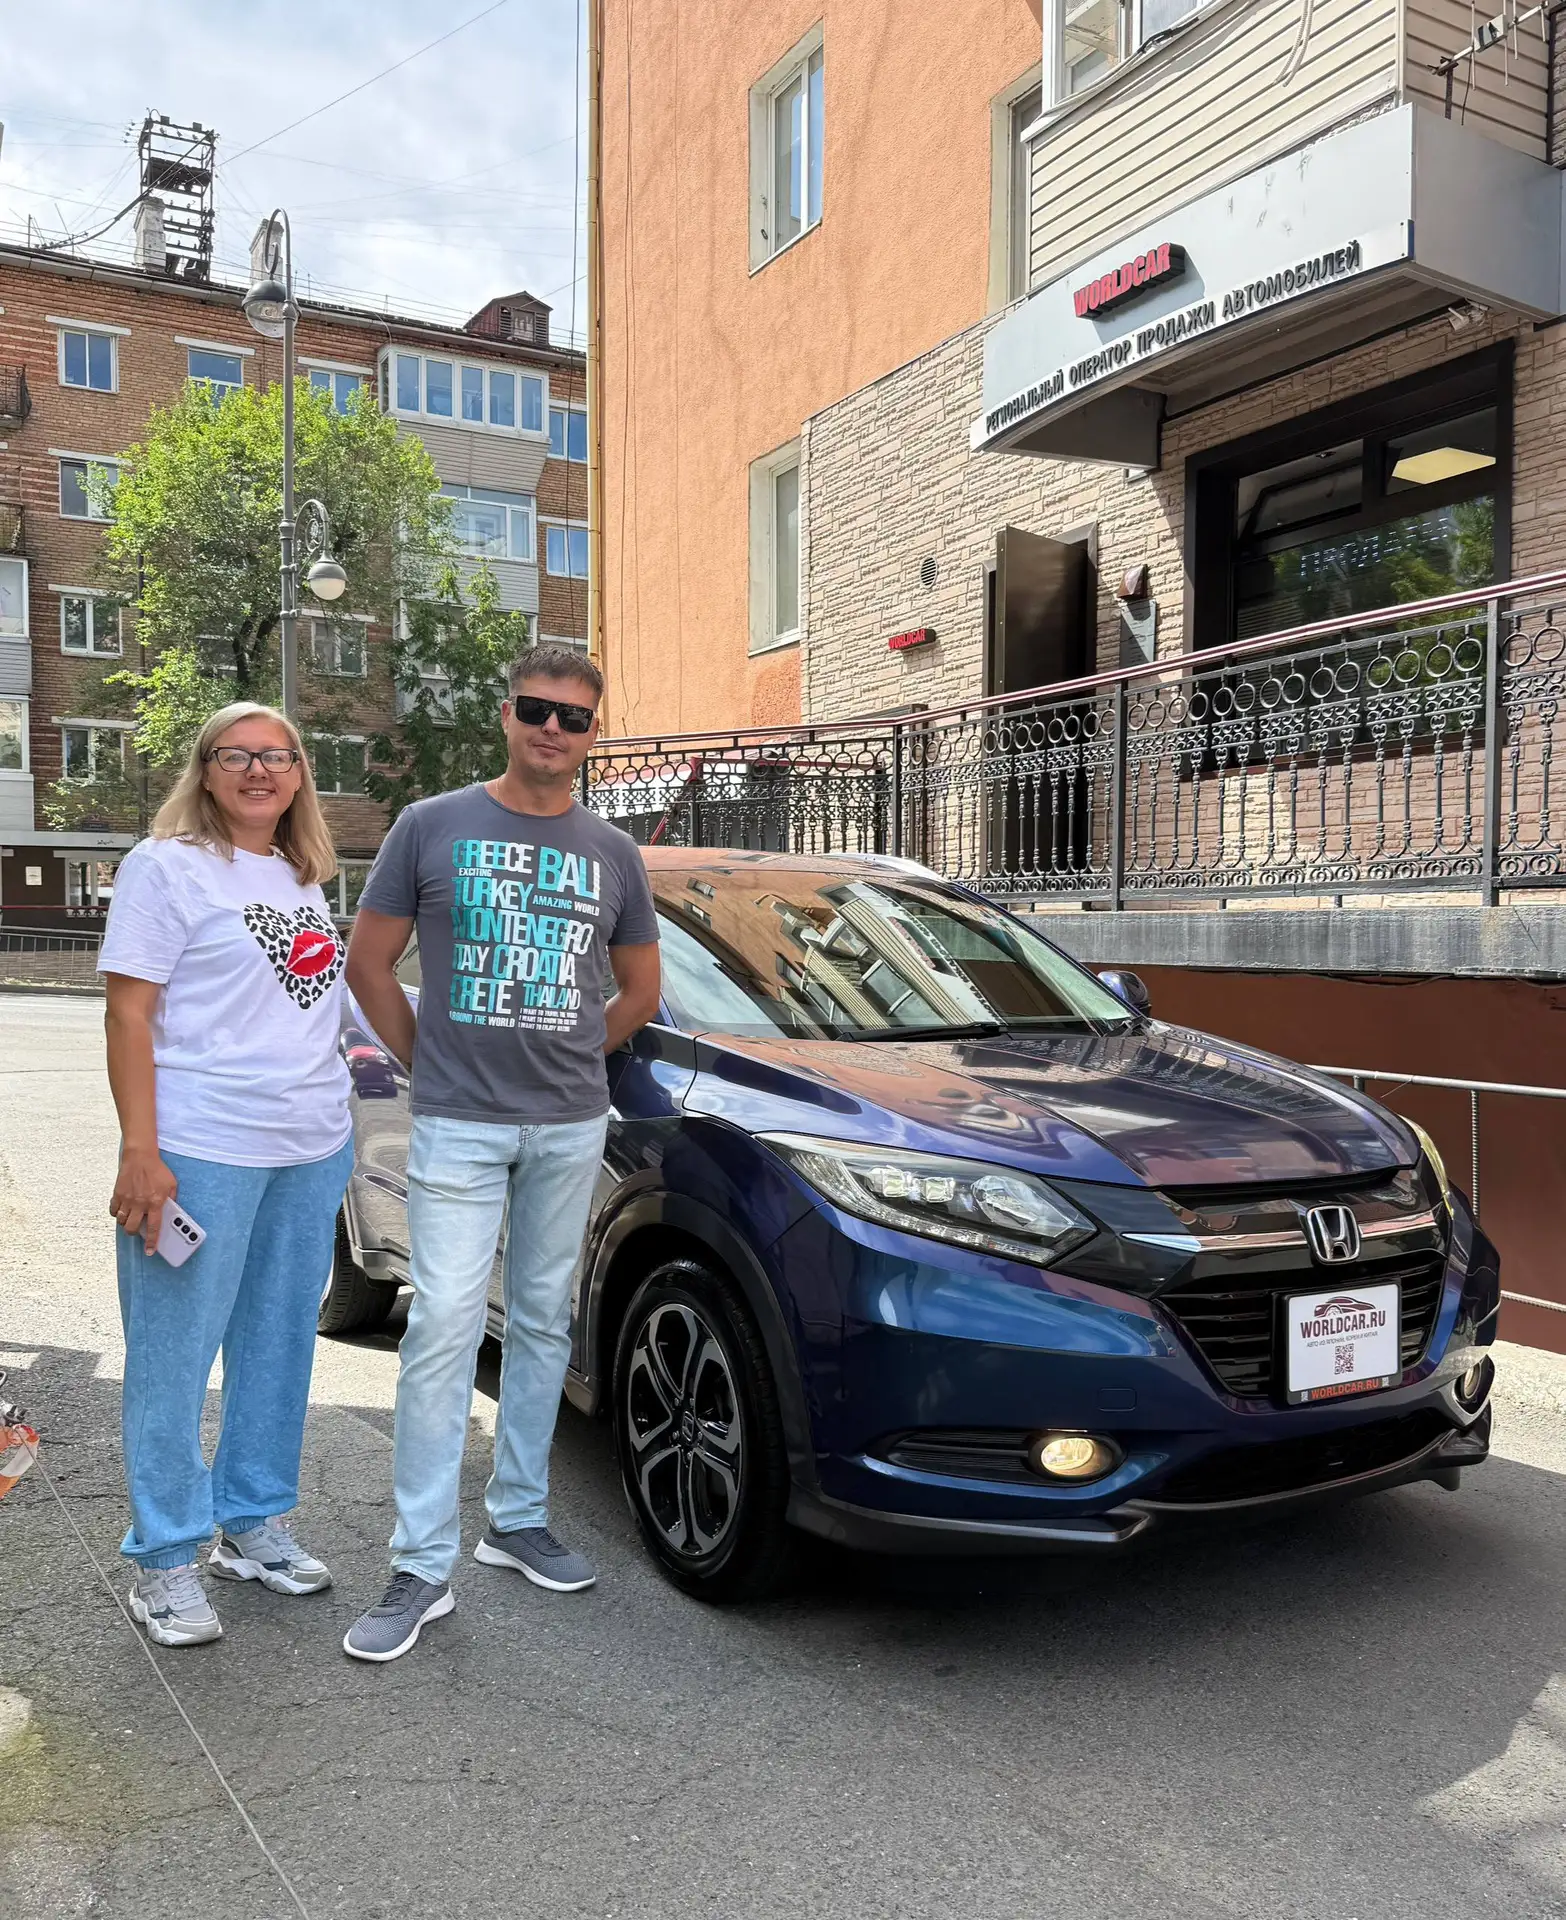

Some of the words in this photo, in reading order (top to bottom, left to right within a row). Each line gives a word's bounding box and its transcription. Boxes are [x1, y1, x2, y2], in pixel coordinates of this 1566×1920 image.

[1074, 242, 1171, 317] WORLDCAR
[986, 368, 1064, 435] РЕГИОНАЛЬНЫЙ
[1069, 340, 1132, 387] ОПЕРАТОР
[1136, 301, 1216, 355] ПРОДАЖИ
[1222, 239, 1362, 318] АВТОМОБИЛЕЙ
[888, 628, 926, 649] WORLDCAR
[452, 839, 534, 874] GREECE
[458, 867, 492, 877] EXCITING
[537, 846, 600, 901] BALI
[451, 876, 534, 912] TURKEY
[532, 895, 572, 910] AMAZING
[574, 900, 600, 917] WORLD
[450, 906, 594, 955] MONTENEGRO
[453, 944, 490, 973] ITALY
[492, 944, 576, 987] CROATIA
[450, 974, 514, 1015] CRETE
[474, 1014, 487, 1026] THE
[488, 1015, 515, 1028] WORLD
[520, 1022, 535, 1030] WANT
[523, 1008, 537, 1016] WANT
[1300, 1310, 1386, 1339] WORLDCAR.RU
[1311, 1378, 1380, 1400] WORLDCAR.RU
